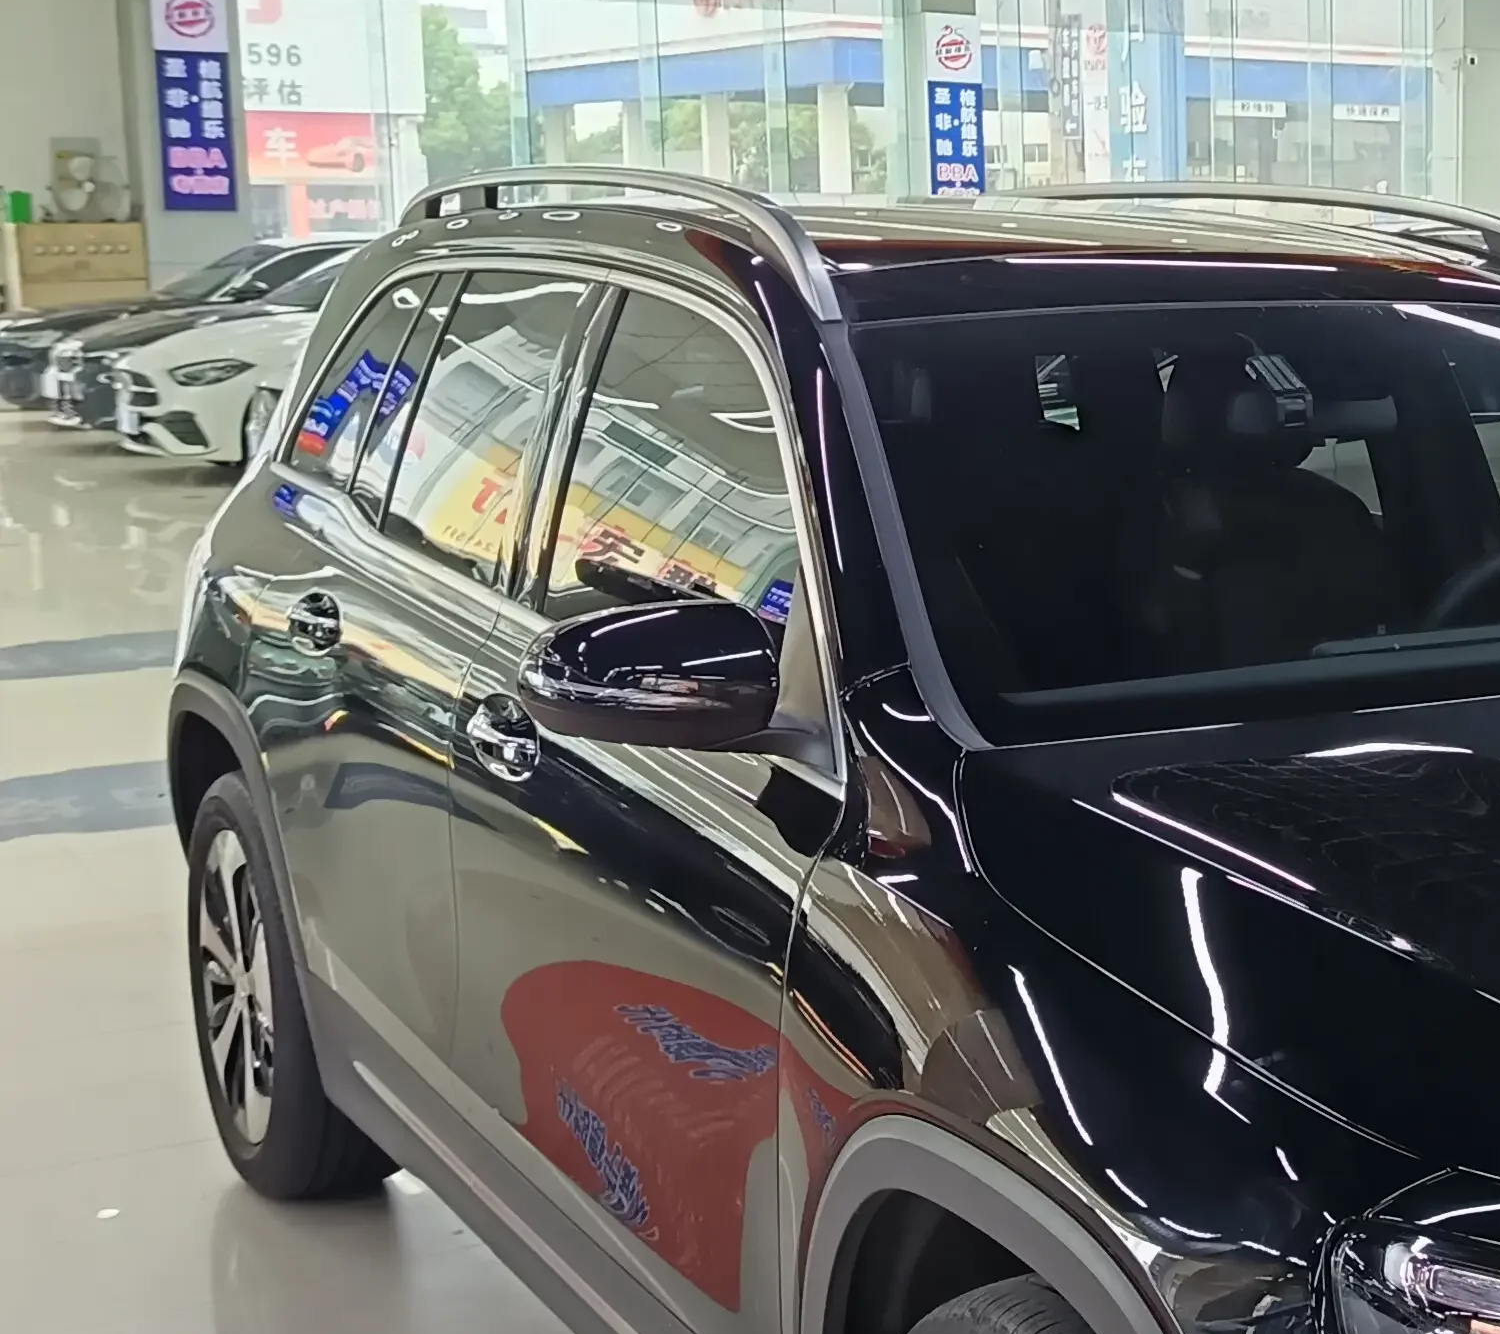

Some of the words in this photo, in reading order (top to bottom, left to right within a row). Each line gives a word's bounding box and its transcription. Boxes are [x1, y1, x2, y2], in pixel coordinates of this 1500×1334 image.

[247, 43, 302, 66] 596
[262, 127, 298, 164] 车
[937, 162, 979, 182] BBA
